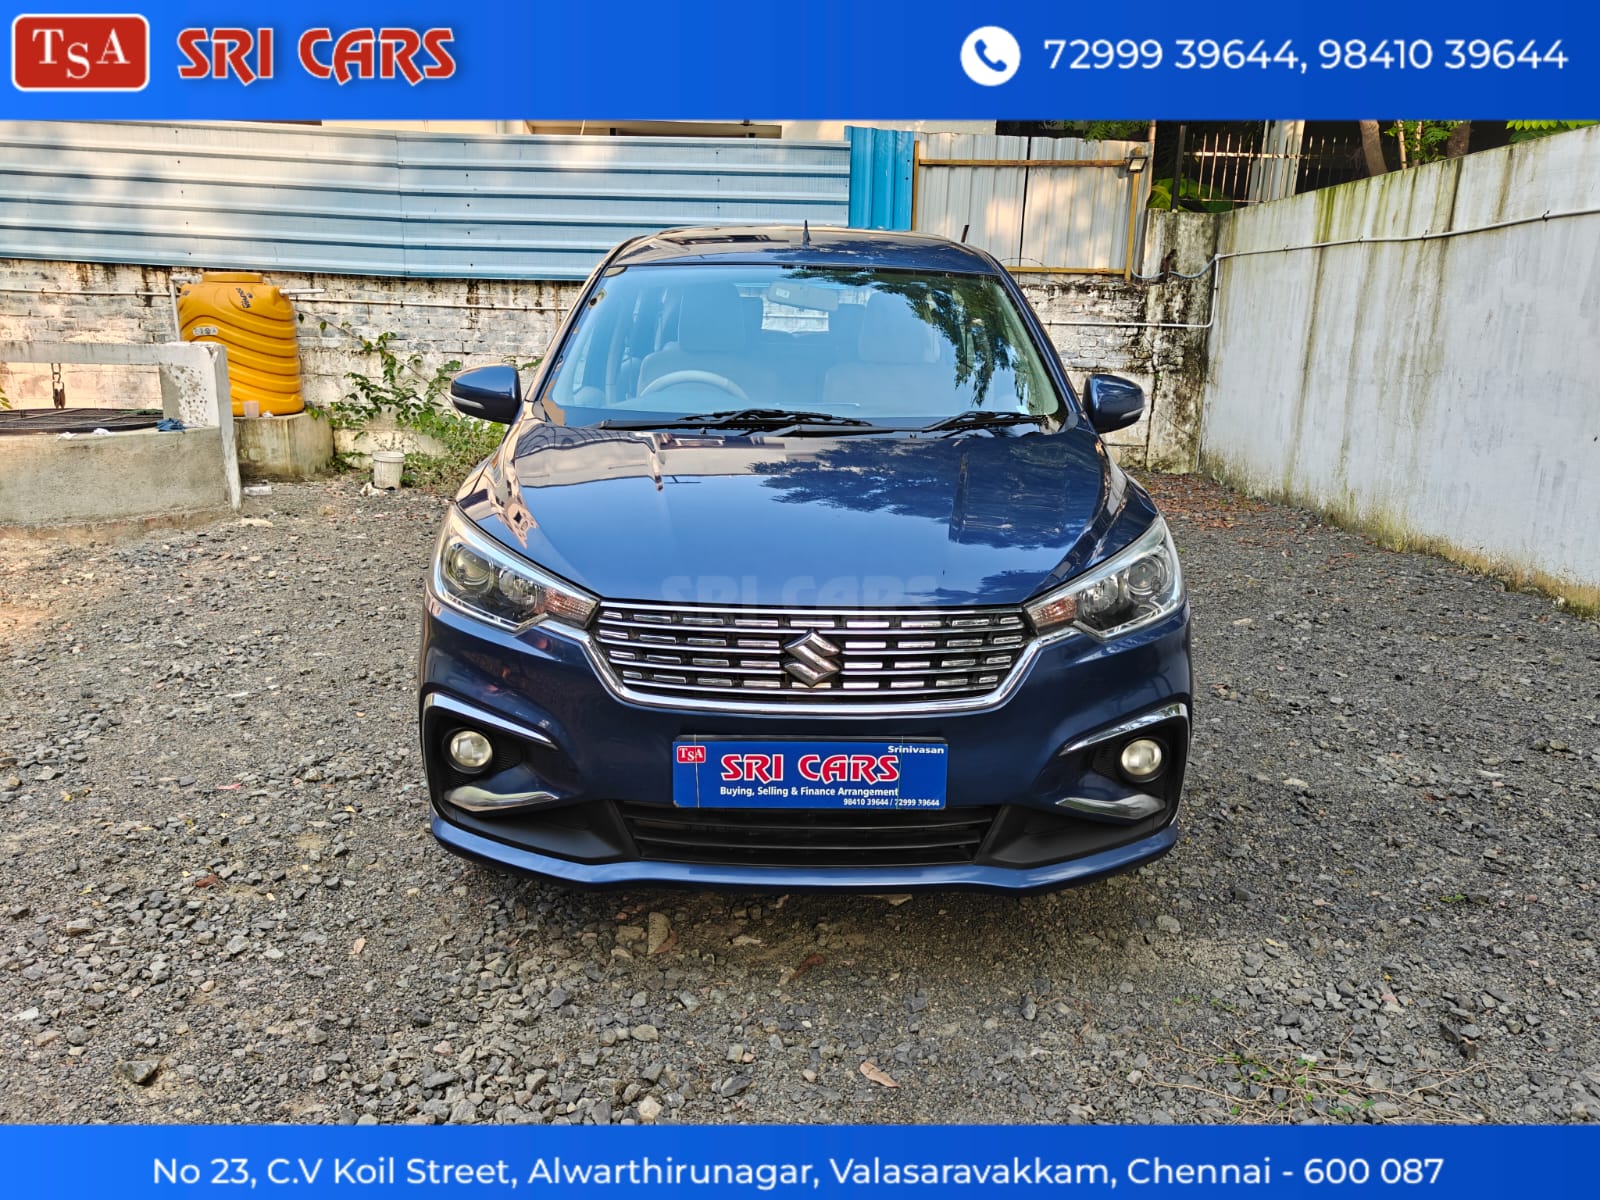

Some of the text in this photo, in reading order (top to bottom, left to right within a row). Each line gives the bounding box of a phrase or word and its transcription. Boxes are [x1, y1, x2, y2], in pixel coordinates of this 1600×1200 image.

[887, 745, 945, 754] Srinivasan
[721, 754, 900, 785] SRI CARS
[720, 786, 899, 797] Buying, Selling & Finance Arrangement
[843, 798, 865, 806] 98410
[867, 798, 889, 806] 39644
